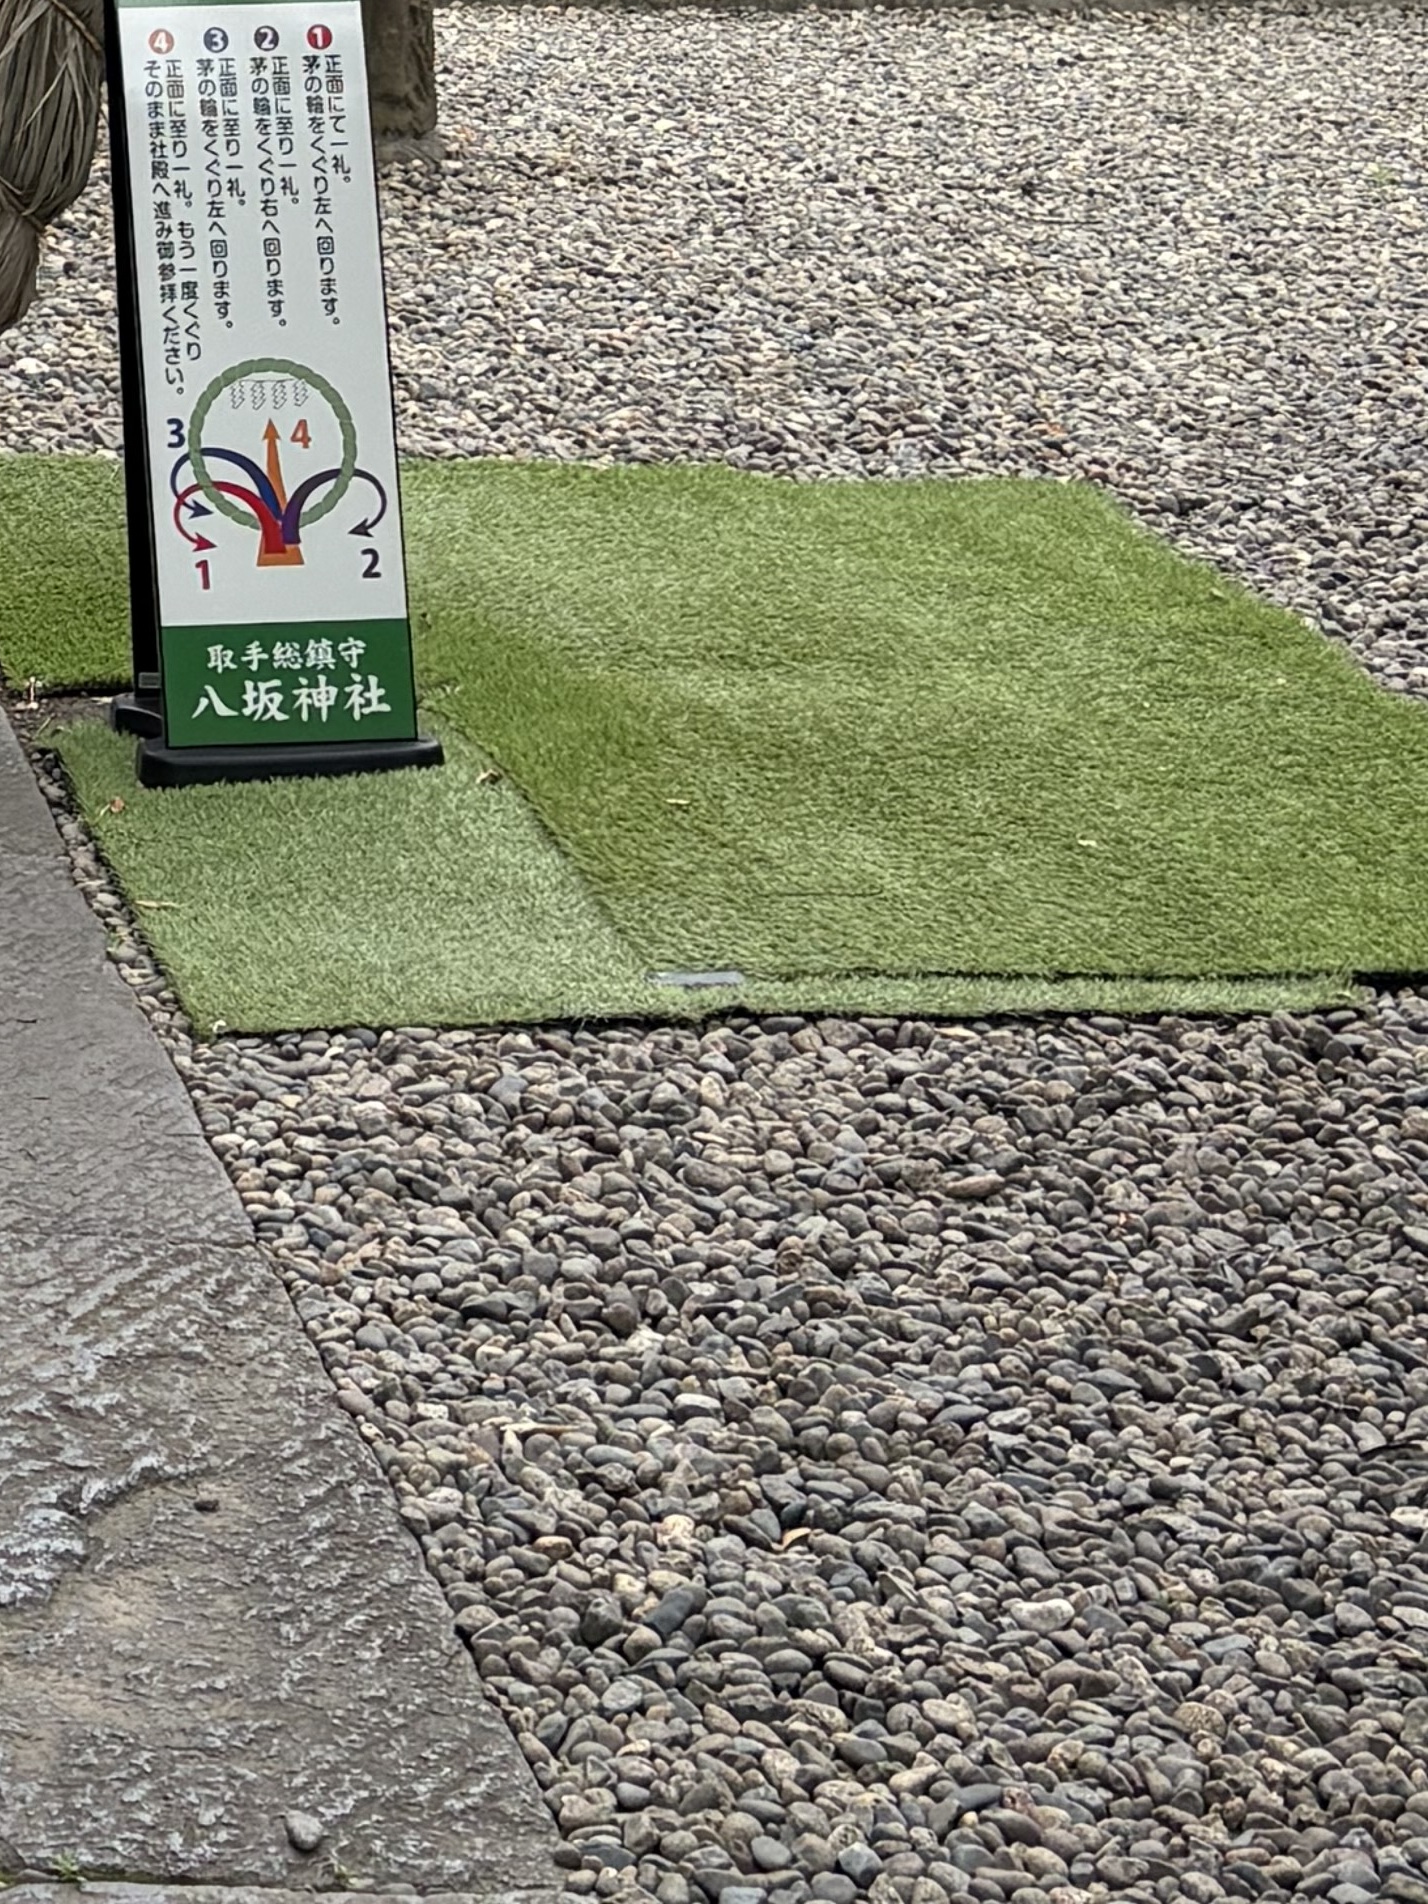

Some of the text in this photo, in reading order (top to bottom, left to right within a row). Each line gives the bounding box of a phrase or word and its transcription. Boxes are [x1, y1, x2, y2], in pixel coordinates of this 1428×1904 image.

[218, 58, 246, 206] 正面に至り一礼。
[272, 56, 300, 205] 正面に至り一礼。
[325, 54, 351, 184] 正面にて一礼。
[144, 60, 185, 395] そのまま社殿へ進み御参拝ください。
[196, 58, 234, 329] 茅の輪をくぐり左へ回ります。
[250, 56, 287, 327] 茅の輪をくぐり右へ回ります。
[302, 54, 341, 325] 茅の輪をくぐり左へ回ります。
[166, 418, 186, 449] 3
[290, 418, 312, 449] 4
[195, 560, 211, 591] 1
[360, 548, 382, 579] 2
[191, 672, 393, 723] 八坂神社
[207, 637, 367, 674] 取手総鎮守
